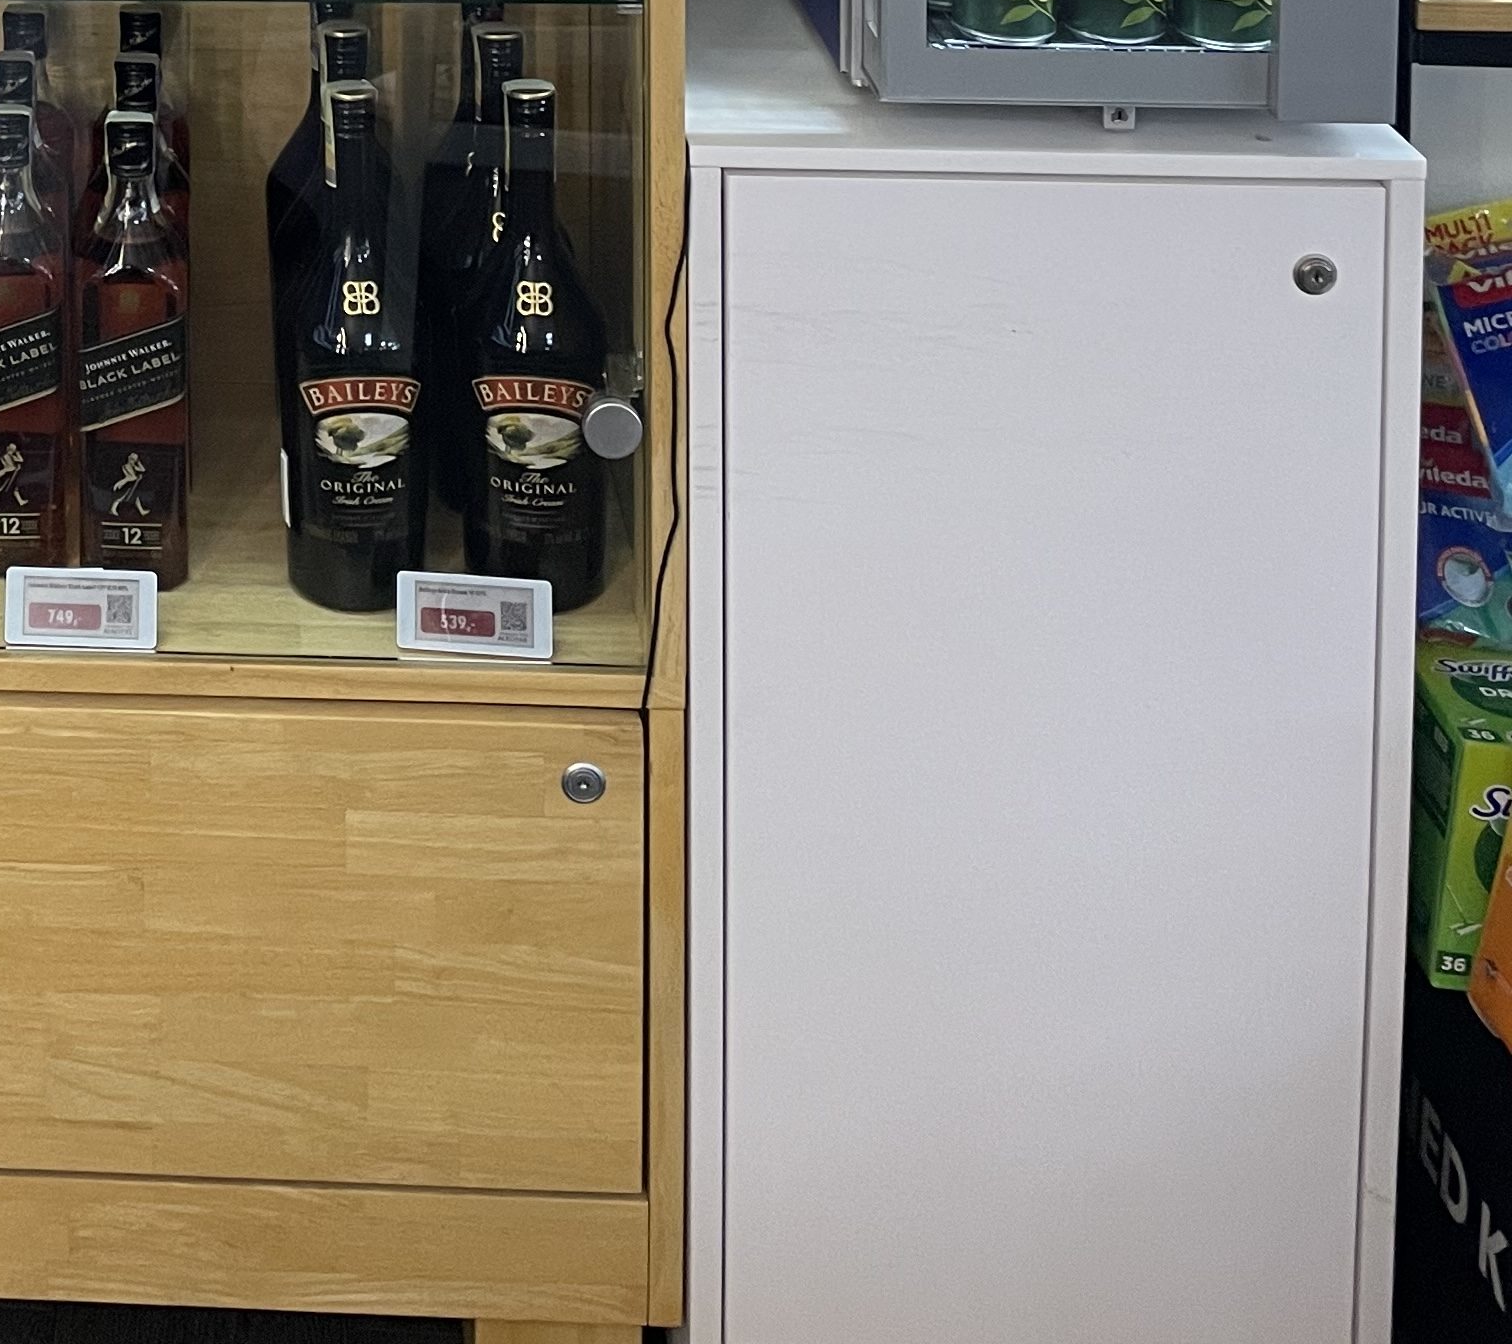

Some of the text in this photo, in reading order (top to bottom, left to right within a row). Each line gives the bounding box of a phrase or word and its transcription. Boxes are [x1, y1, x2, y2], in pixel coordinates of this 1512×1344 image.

[1424, 215, 1492, 244] MULTI
[10, 343, 56, 365] LABEL
[80, 352, 180, 390] BLACK LABEL
[86, 354, 127, 374] JOHNNIE
[309, 382, 417, 406] BAILEYS
[479, 383, 586, 408] BAILEYS
[320, 478, 406, 494] ORIGINAL
[351, 472, 379, 483] The
[490, 477, 577, 495] ORIGINAL
[519, 473, 549, 483] The
[1, 518, 21, 534] 12
[122, 528, 142, 544] 12
[48, 609, 82, 626] 749,-
[1467, 728, 1496, 741] 36
[1441, 955, 1466, 973] 36
